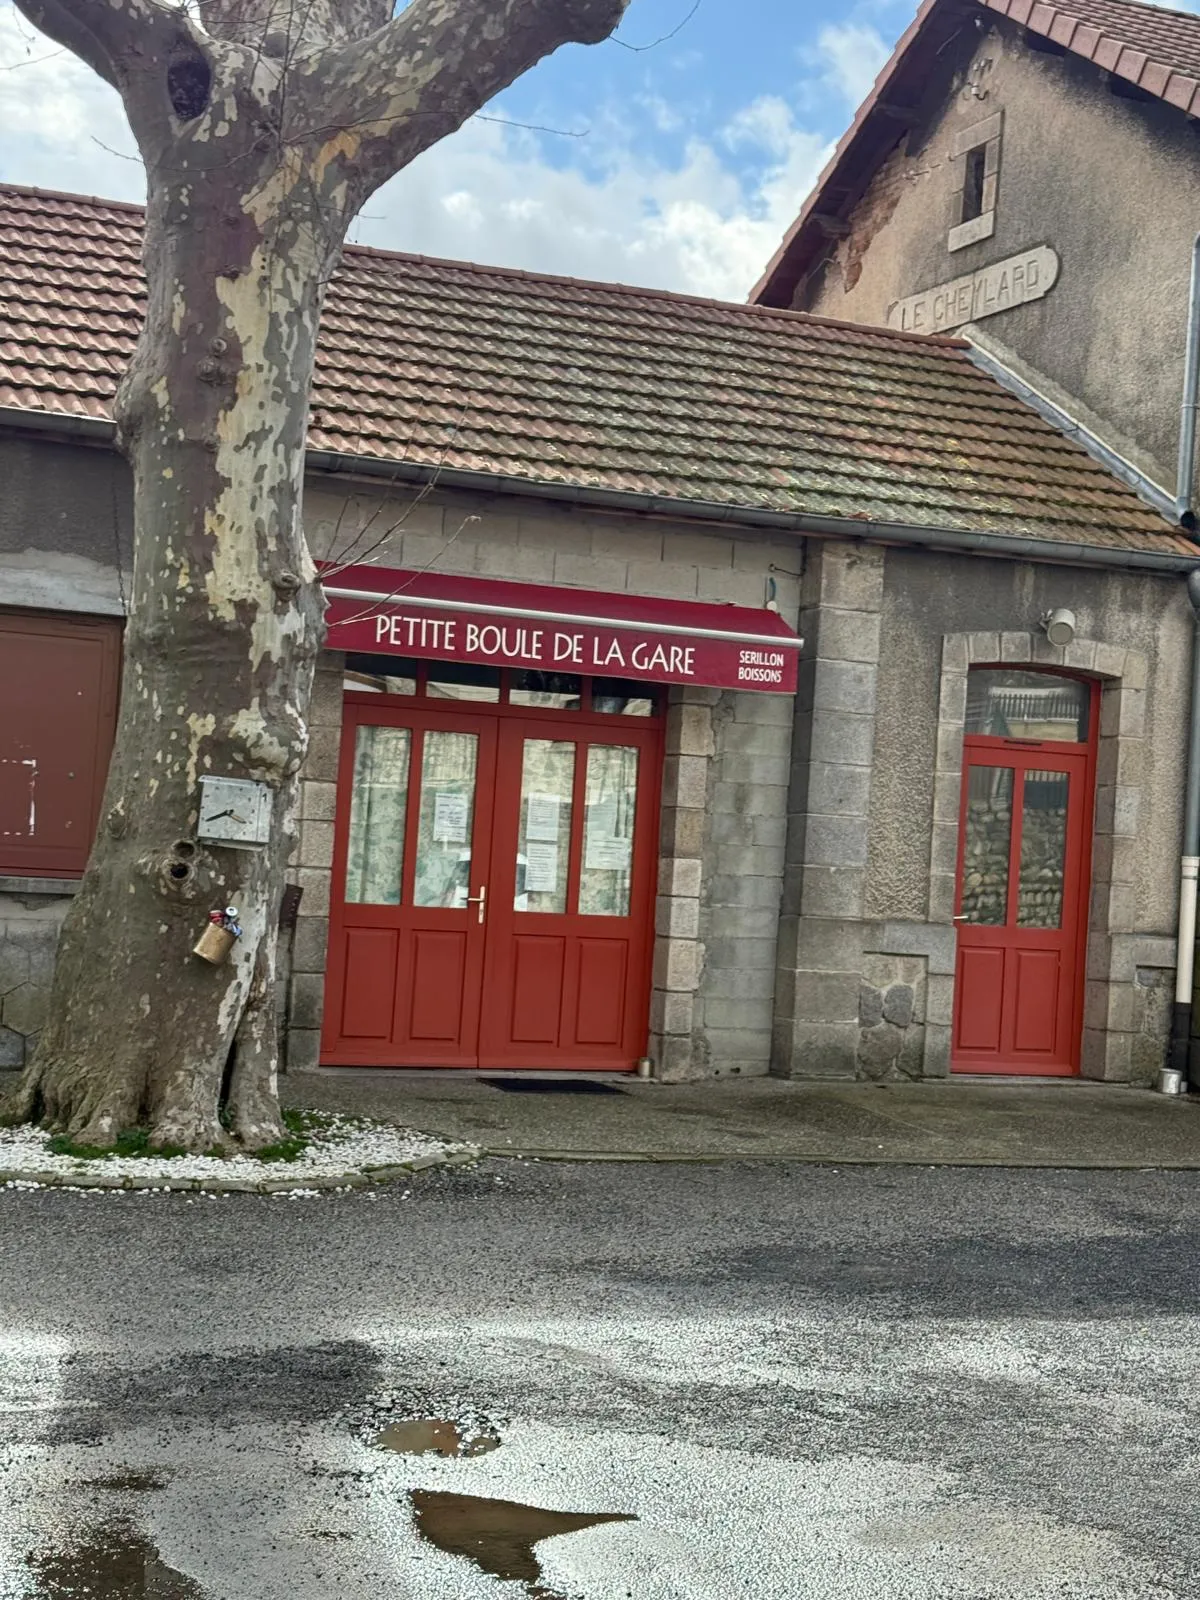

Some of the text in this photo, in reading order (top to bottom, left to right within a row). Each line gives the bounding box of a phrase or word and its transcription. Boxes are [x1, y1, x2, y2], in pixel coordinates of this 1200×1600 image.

[901, 259, 1040, 331] LE CHEYLARD
[376, 615, 696, 675] PETITE BOULE DE LA GARE
[739, 650, 784, 666] SERILLON
[738, 666, 783, 683] BOISSONS
